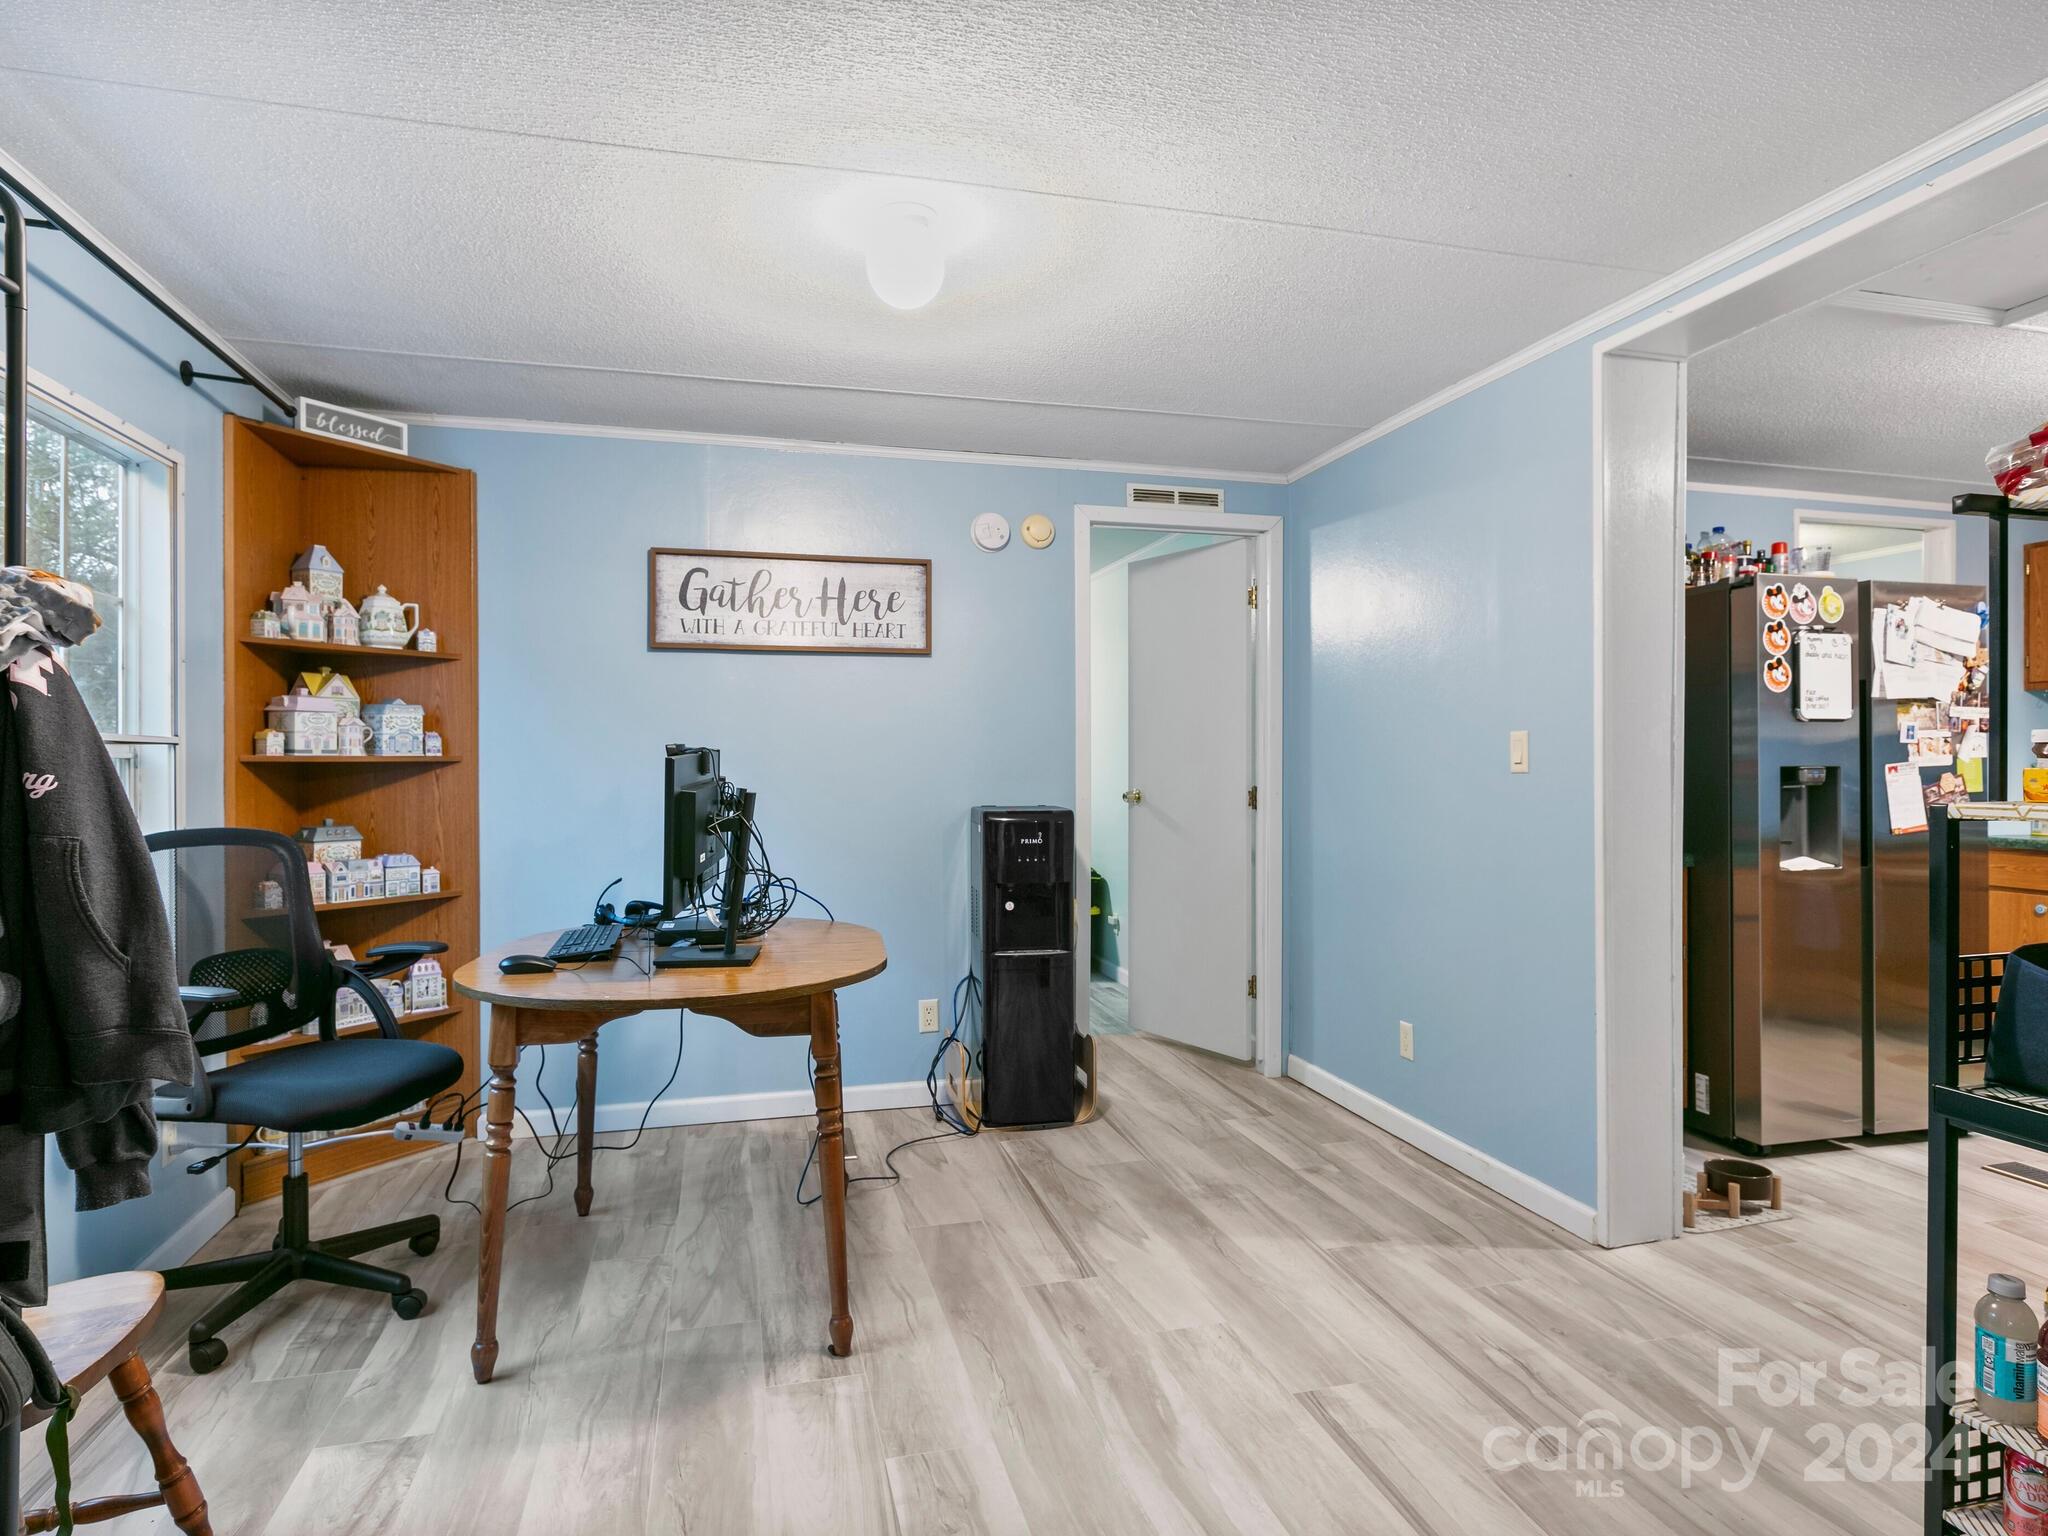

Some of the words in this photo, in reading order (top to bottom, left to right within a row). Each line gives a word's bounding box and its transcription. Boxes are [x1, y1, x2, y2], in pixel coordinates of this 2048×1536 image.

[316, 412, 386, 441] blessed
[678, 567, 813, 618] Gather
[816, 576, 906, 625] Here
[681, 618, 725, 635] WITH
[734, 620, 744, 635] A
[754, 620, 845, 638] GRATEFUL
[852, 622, 907, 639] HEART
[1021, 836, 1042, 844] PRIMO
[2013, 1342, 2026, 1399] vitaminwate
[2012, 1476, 2048, 1494] CANA
[2027, 1491, 2048, 1504] DR
